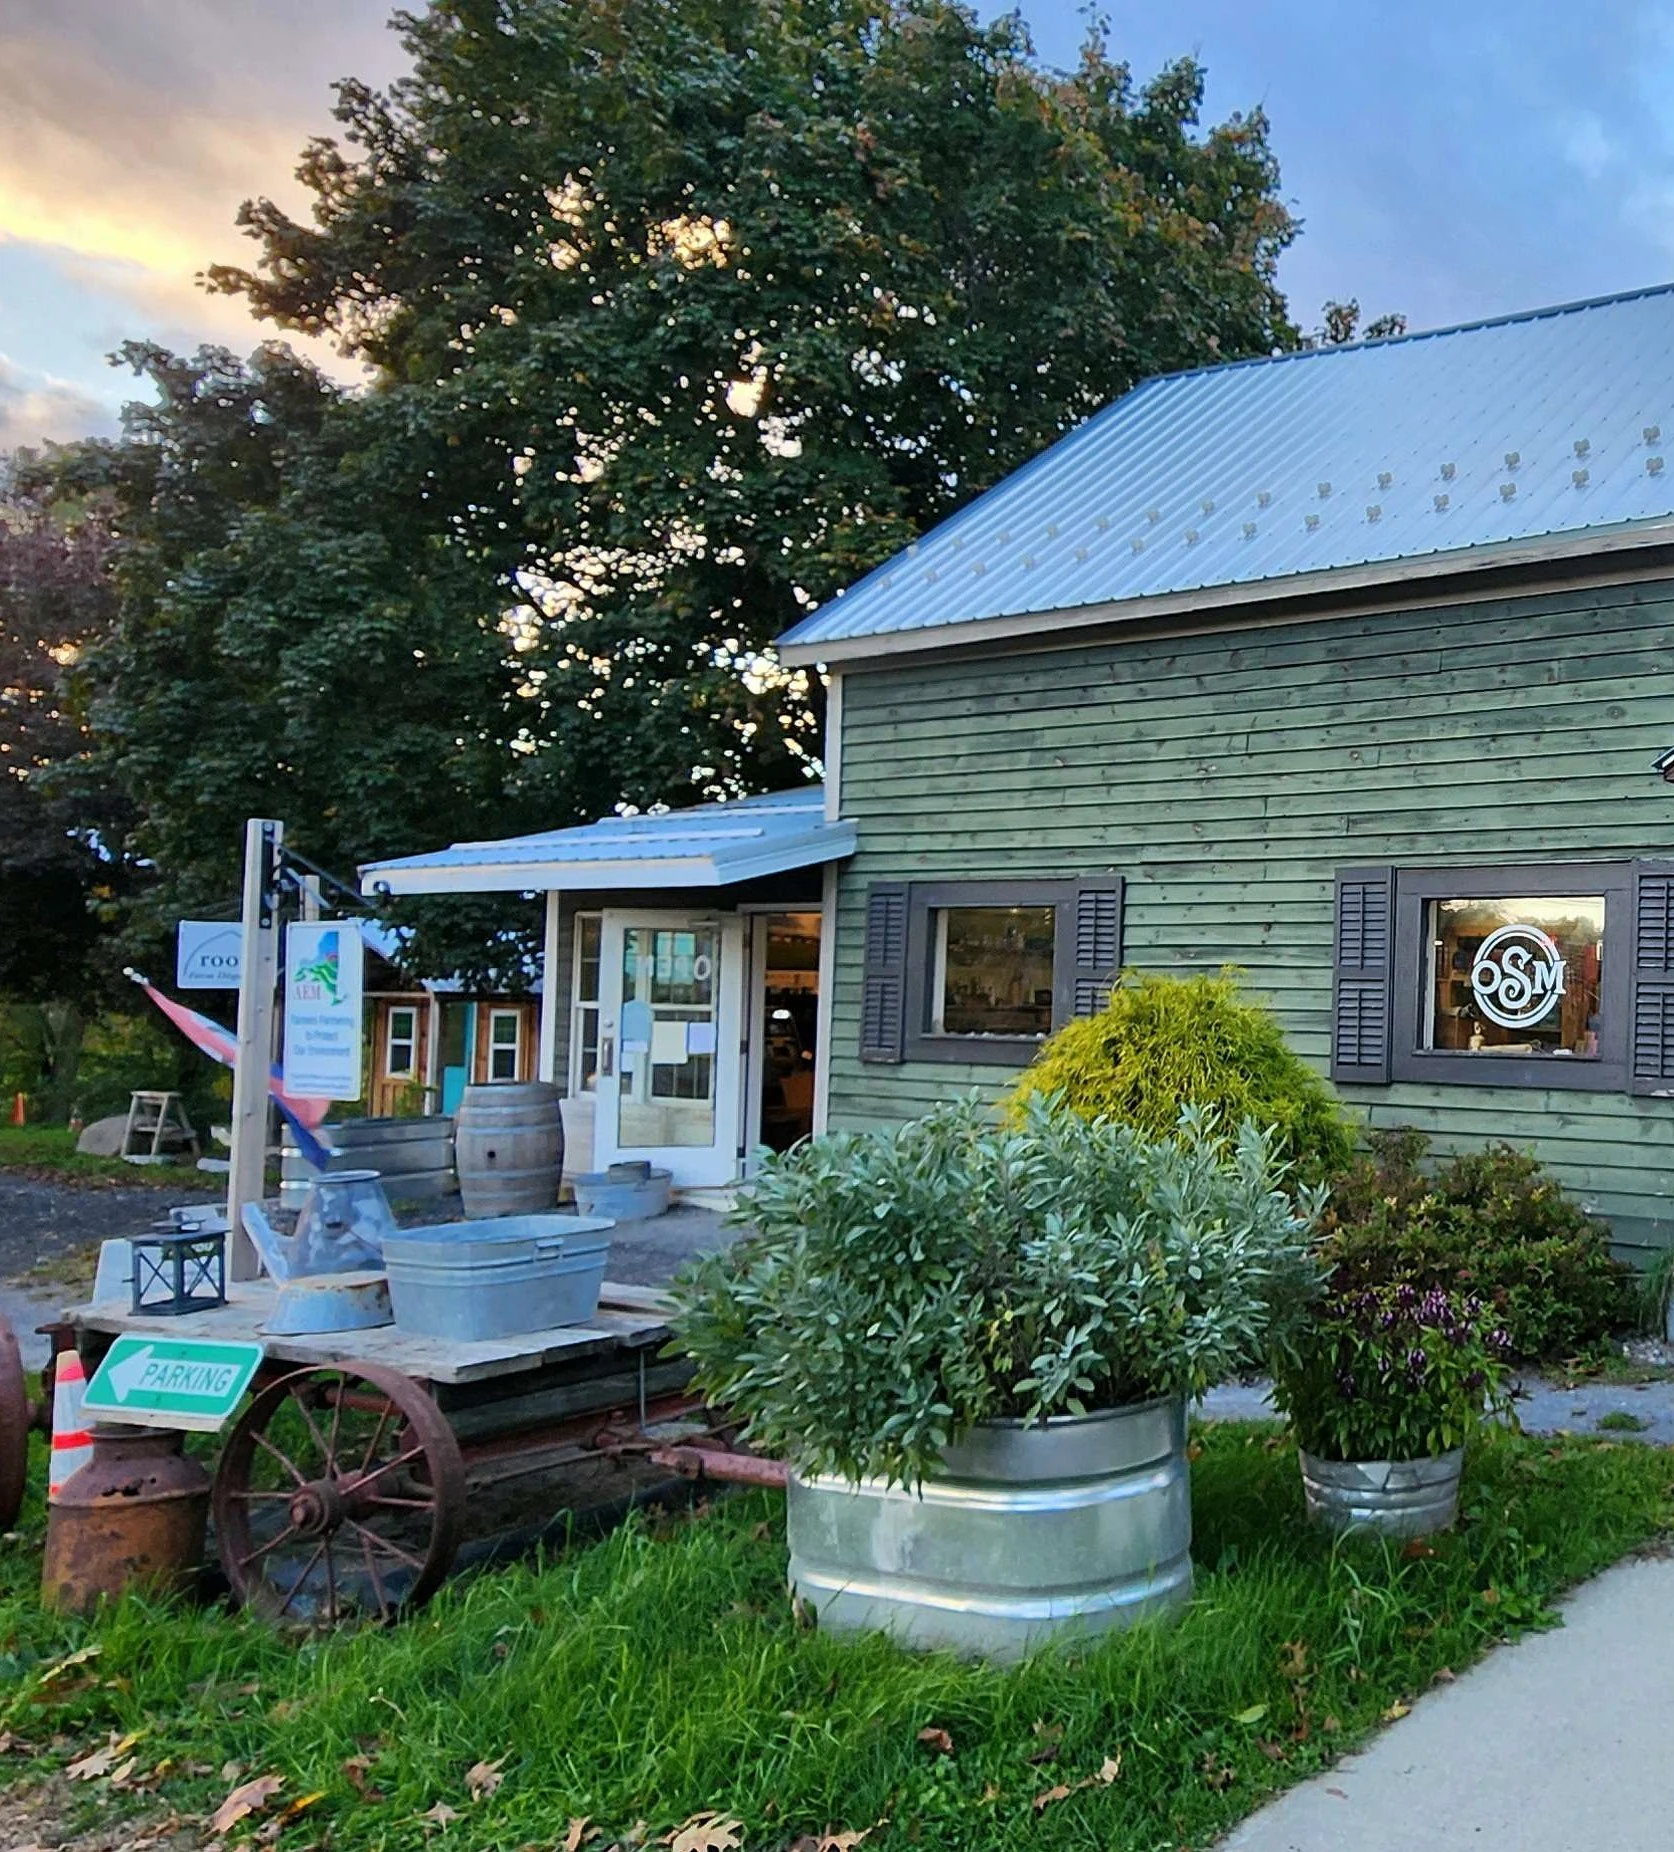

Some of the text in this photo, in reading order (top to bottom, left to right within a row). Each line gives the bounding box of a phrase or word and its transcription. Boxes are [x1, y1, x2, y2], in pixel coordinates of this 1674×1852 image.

[201, 955, 239, 968] roo
[1471, 946, 1567, 1009] OSM
[294, 984, 320, 1000] AEM
[139, 1363, 233, 1391] PARKING
